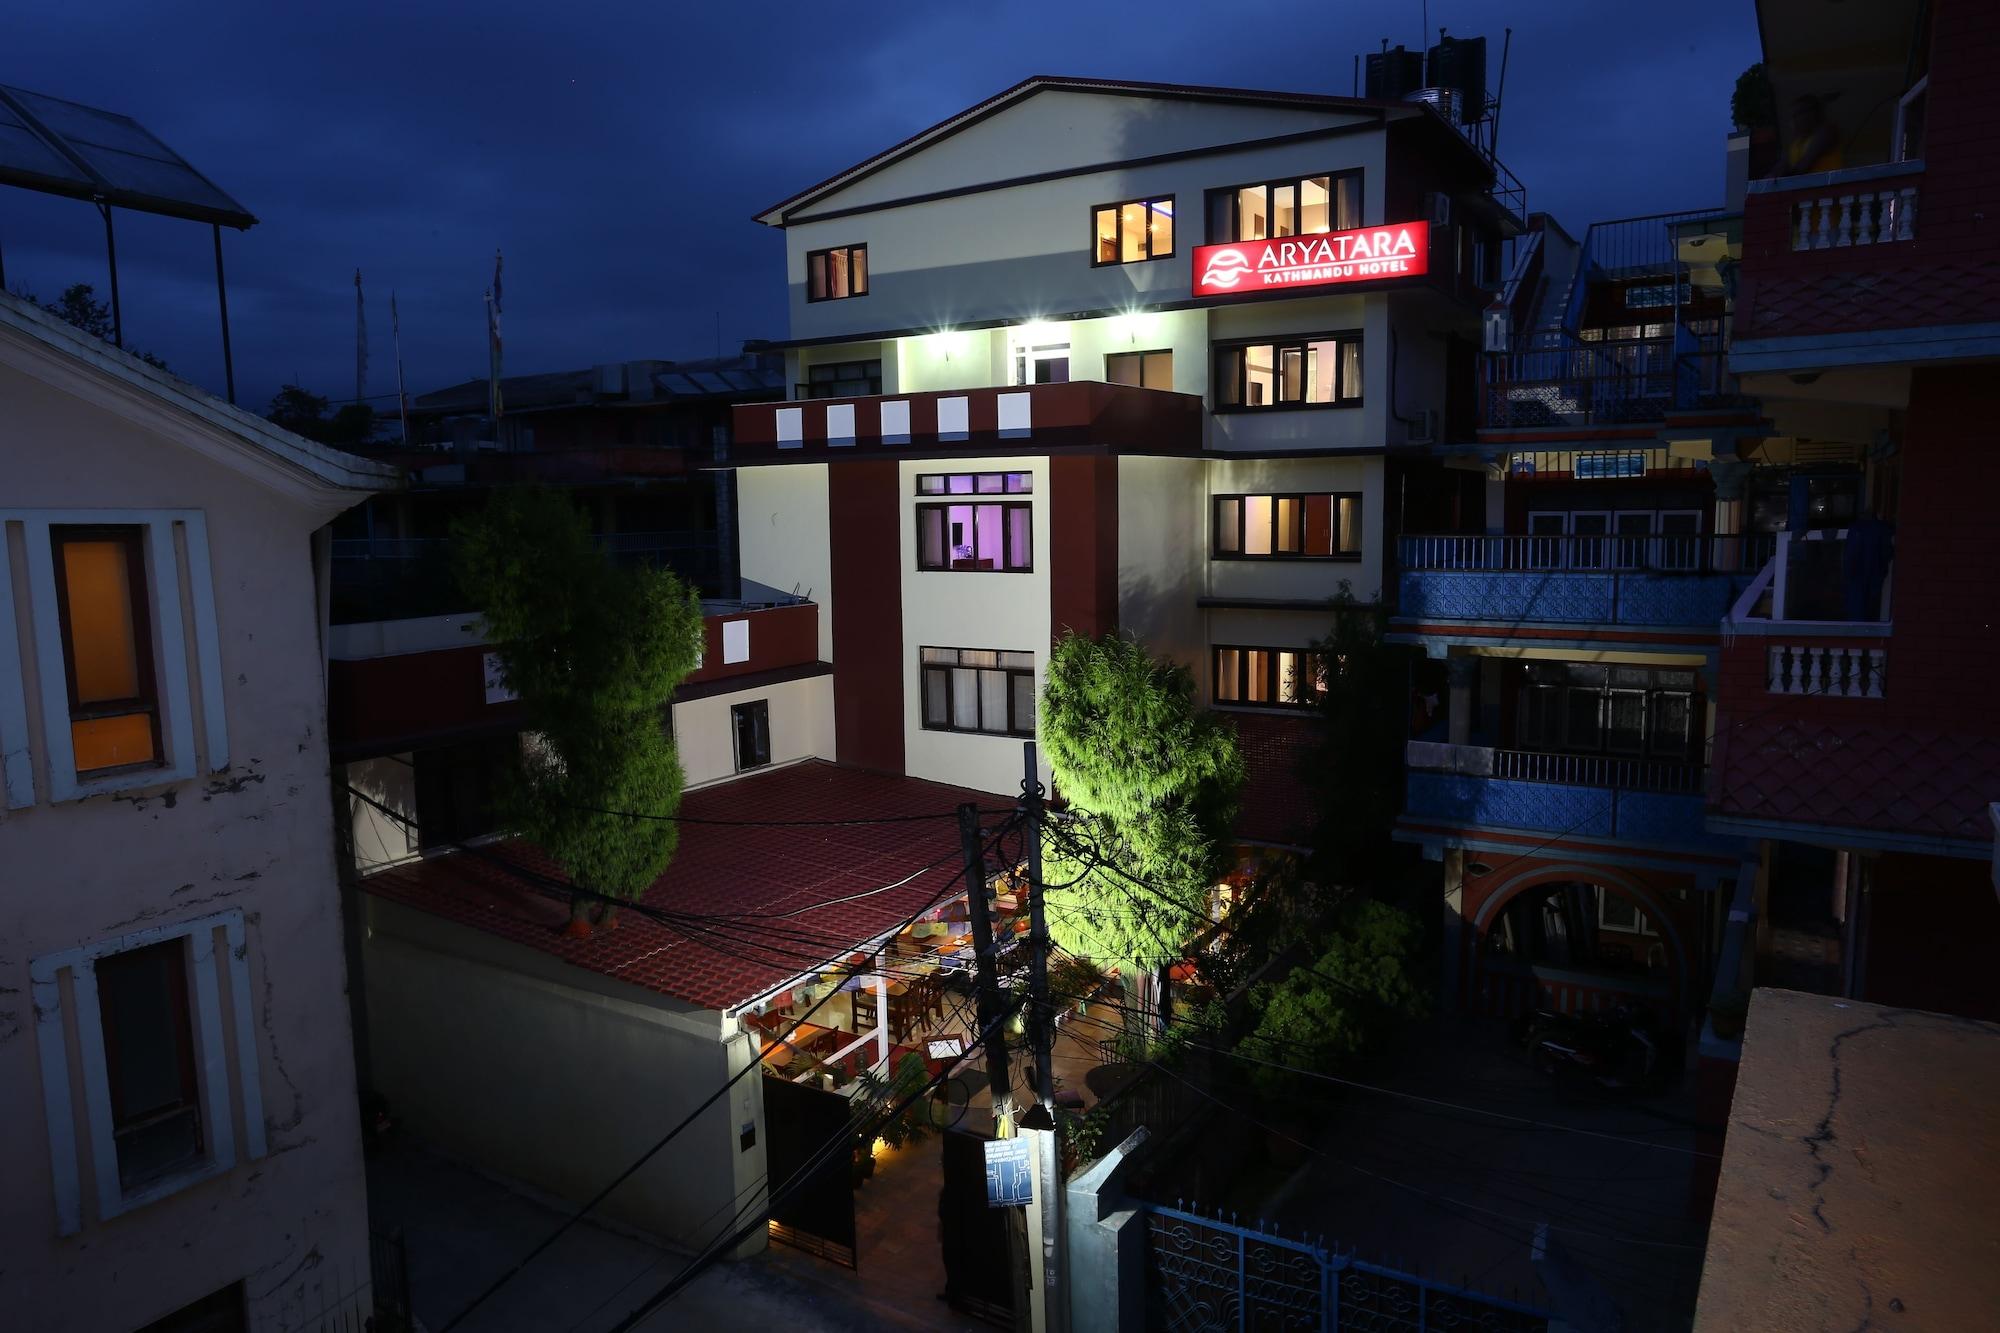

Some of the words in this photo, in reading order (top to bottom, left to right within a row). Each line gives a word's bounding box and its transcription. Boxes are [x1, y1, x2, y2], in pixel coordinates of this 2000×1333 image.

[1258, 229, 1416, 268] ARYATARA
[1264, 266, 1353, 284] KATHMANDU
[1359, 260, 1408, 276] HOTEL
